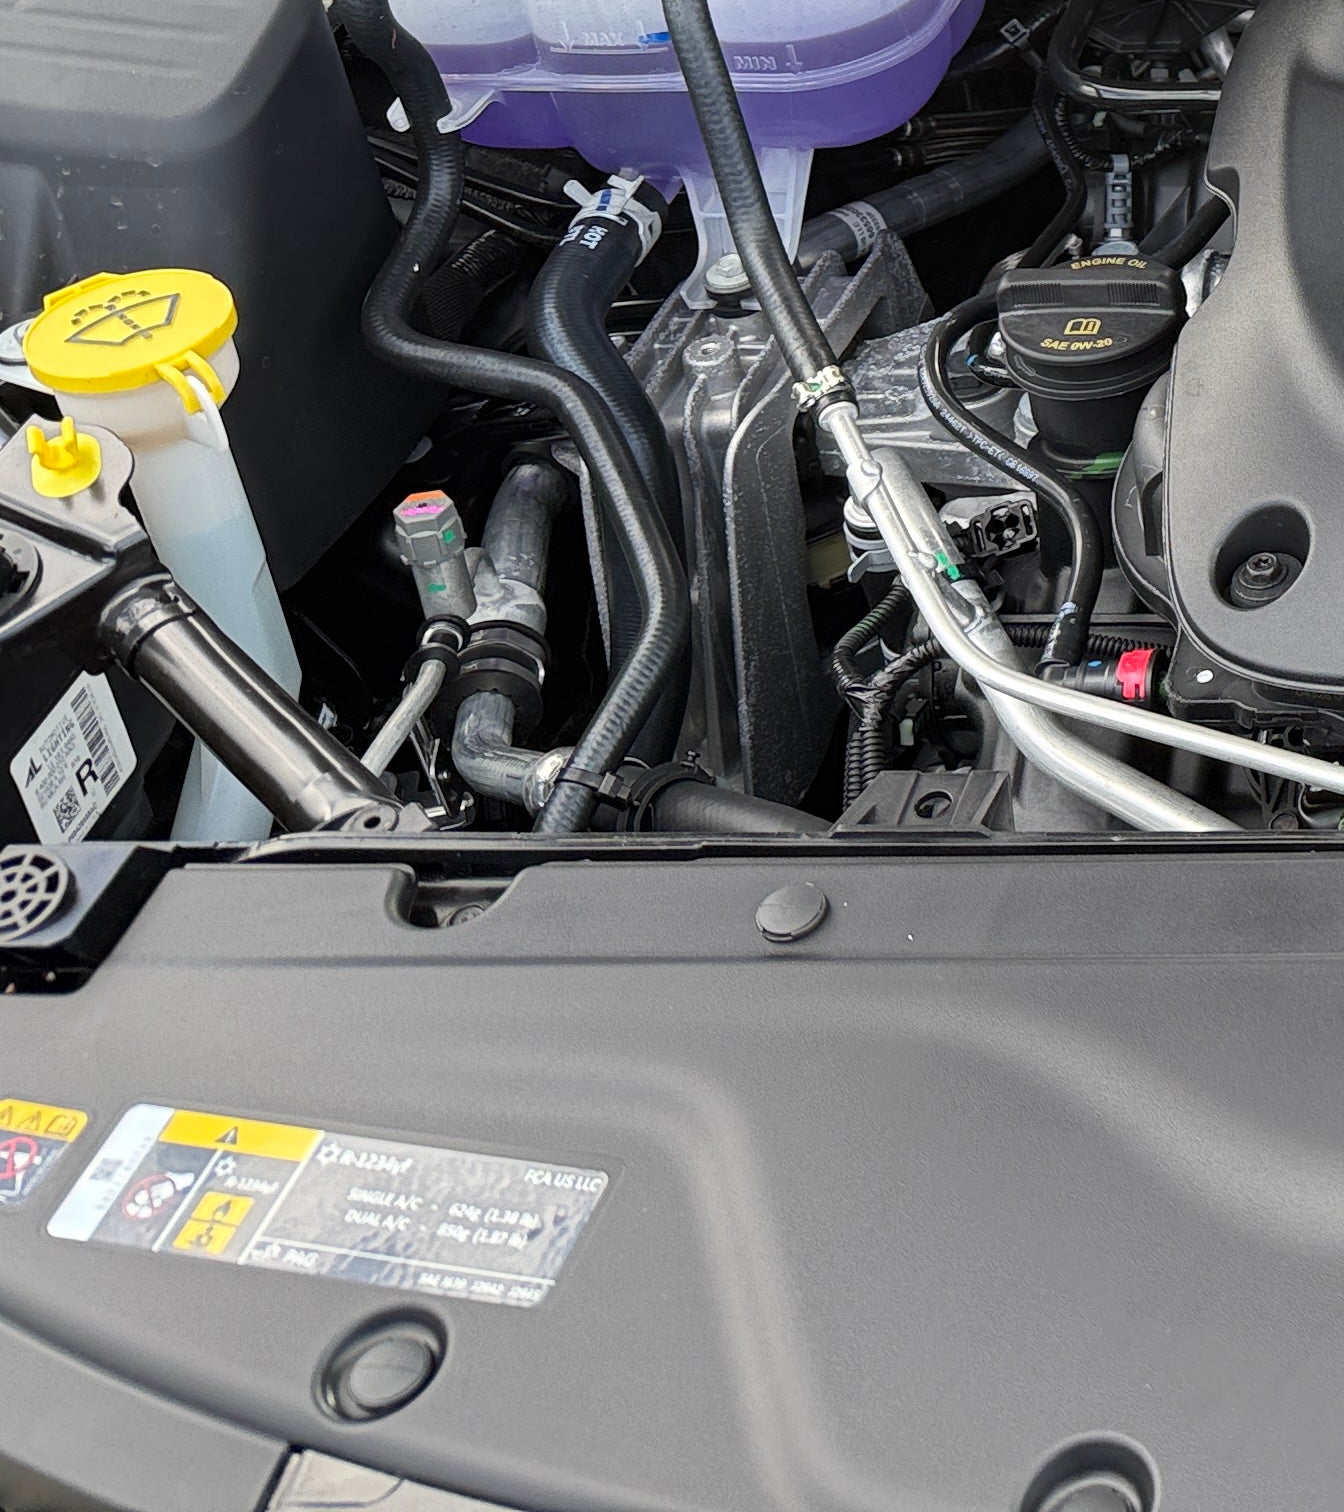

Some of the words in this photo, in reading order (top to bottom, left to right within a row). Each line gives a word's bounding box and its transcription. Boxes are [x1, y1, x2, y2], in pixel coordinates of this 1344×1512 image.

[582, 31, 625, 47] MAX
[733, 55, 778, 70] MIN
[579, 225, 609, 250] HOT
[1070, 256, 1124, 271] ENGINE
[1127, 257, 1148, 270] OIL
[1039, 337, 1069, 352] SAE
[1070, 337, 1113, 351] 0W-20
[76, 756, 99, 797] R
[523, 1168, 553, 1186] FCA
[554, 1171, 574, 1189] US
[574, 1174, 604, 1193] LLC
[344, 1208, 382, 1226] DUAL
